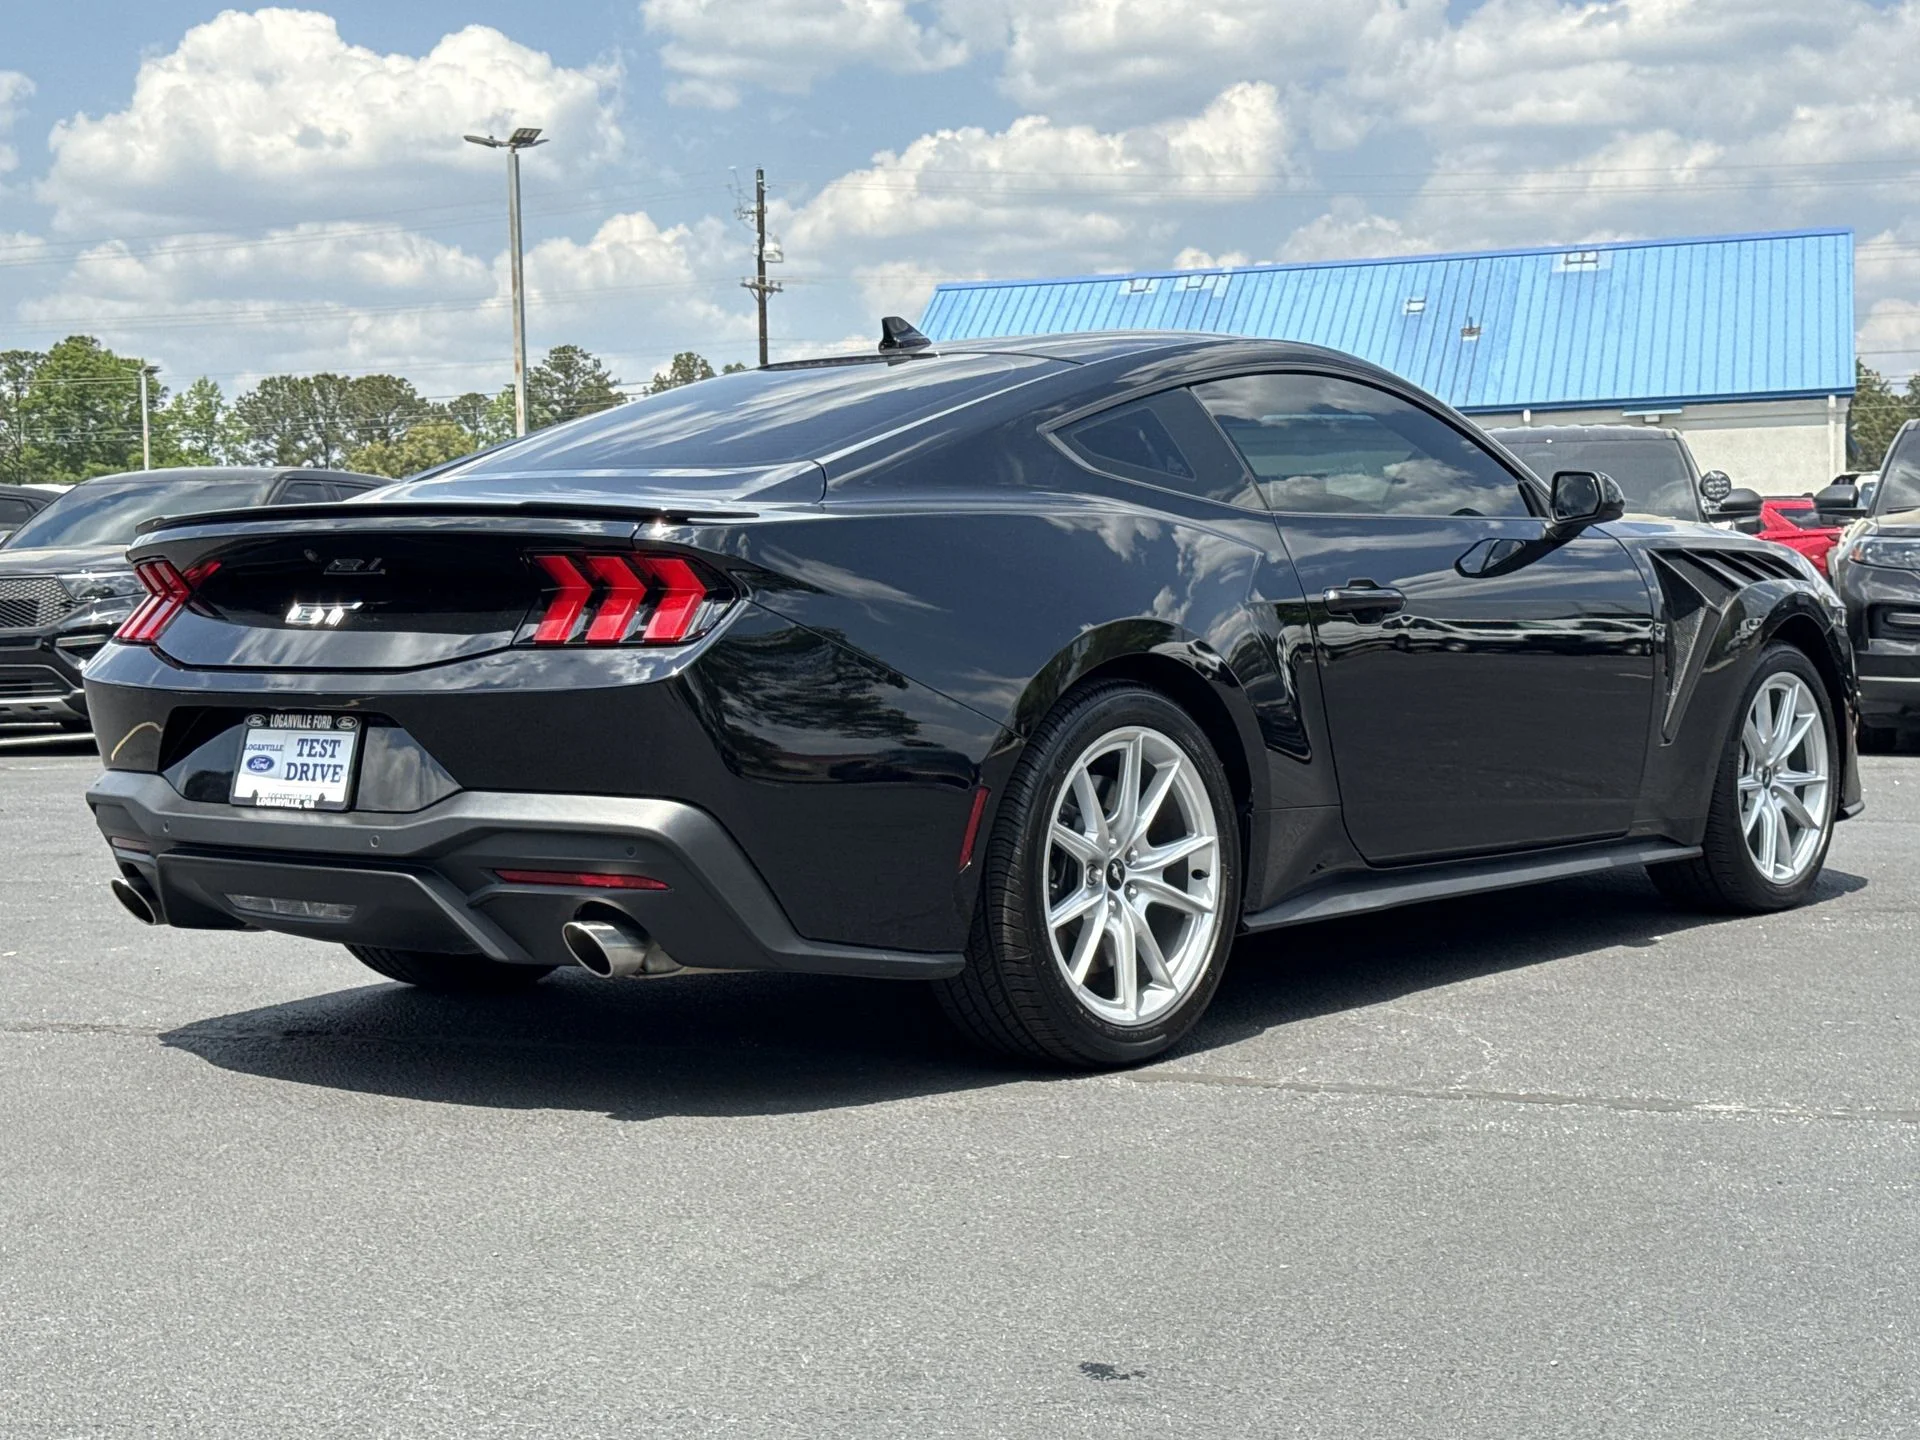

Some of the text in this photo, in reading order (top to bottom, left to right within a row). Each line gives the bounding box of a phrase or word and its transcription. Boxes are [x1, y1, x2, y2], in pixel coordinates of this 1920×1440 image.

[270, 713, 312, 728] LOGANVILLE
[312, 714, 332, 729] FORD
[244, 743, 284, 751] LOGANVILLE
[296, 738, 341, 758] TEST
[251, 757, 270, 770] Ford
[284, 762, 344, 783] DRIVE
